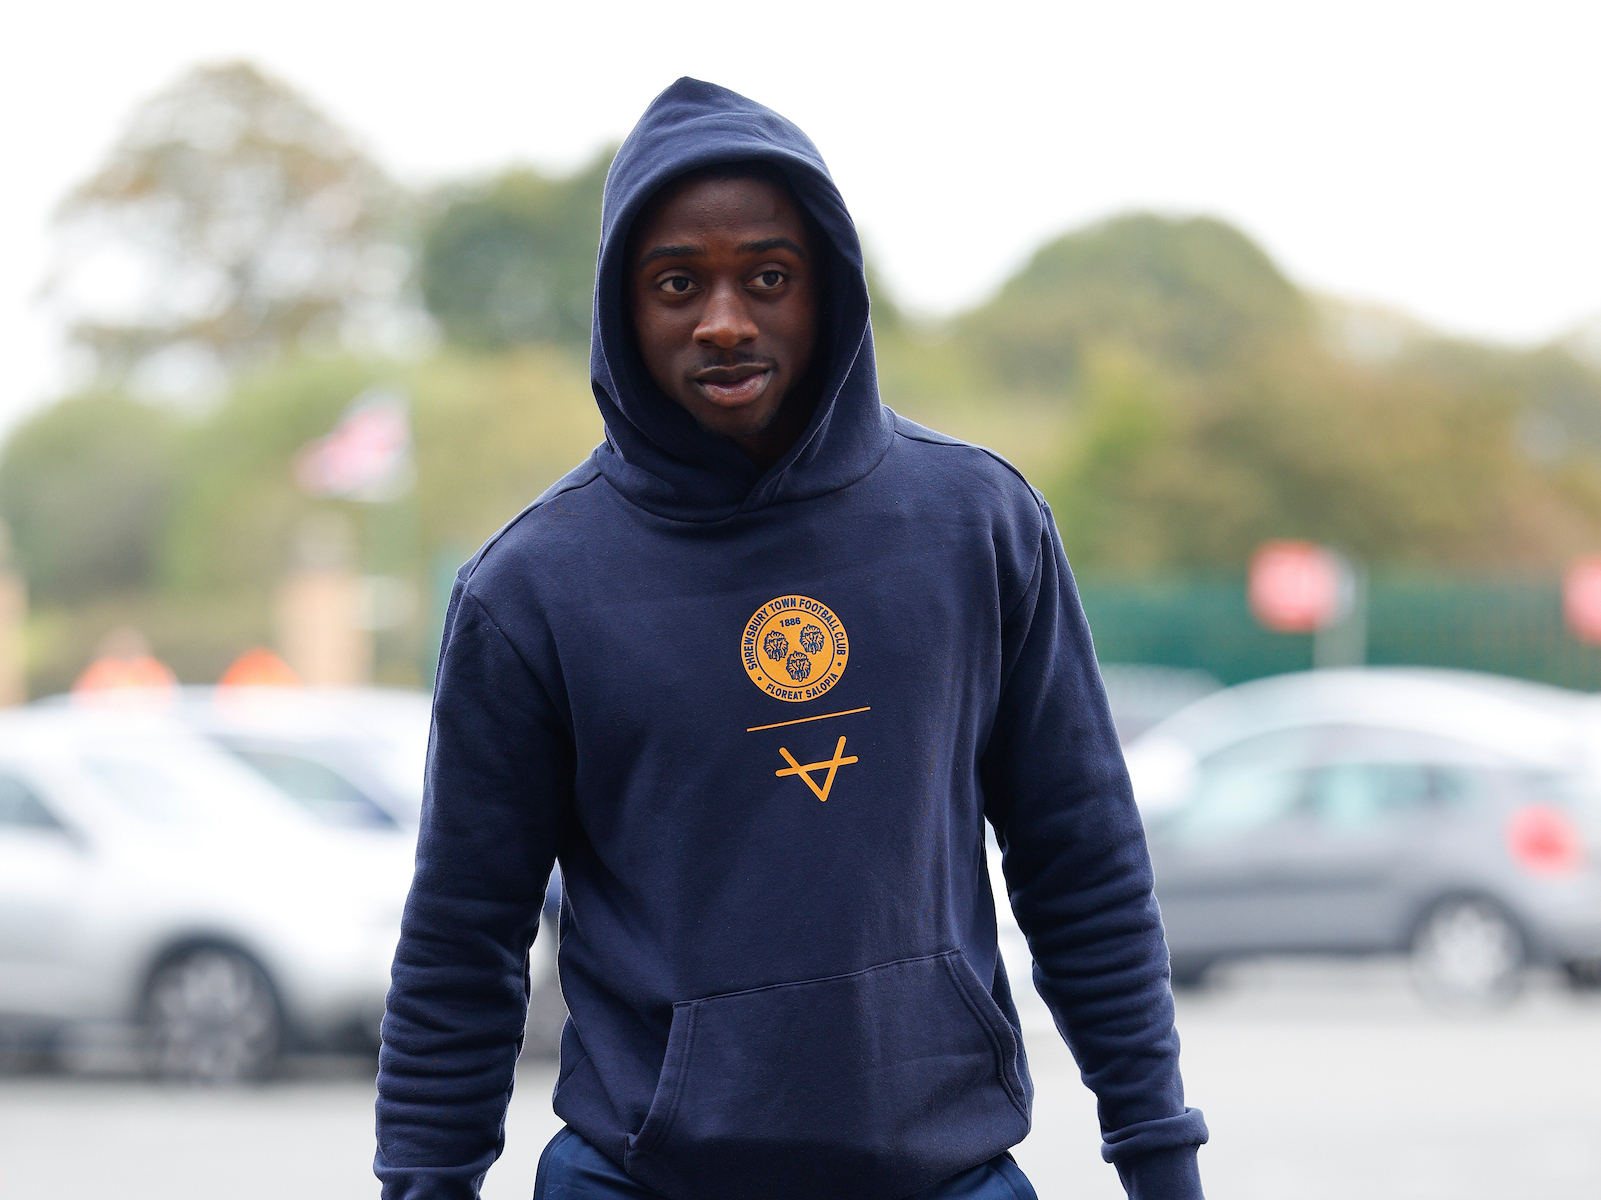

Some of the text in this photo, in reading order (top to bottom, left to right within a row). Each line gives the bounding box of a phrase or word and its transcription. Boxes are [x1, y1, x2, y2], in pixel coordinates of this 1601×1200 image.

[744, 598, 846, 670] SHREWSBURY TOWN FOOTBALL CLUB
[779, 617, 801, 628] 1886
[766, 672, 838, 700] FLOREAT SALOPIA
